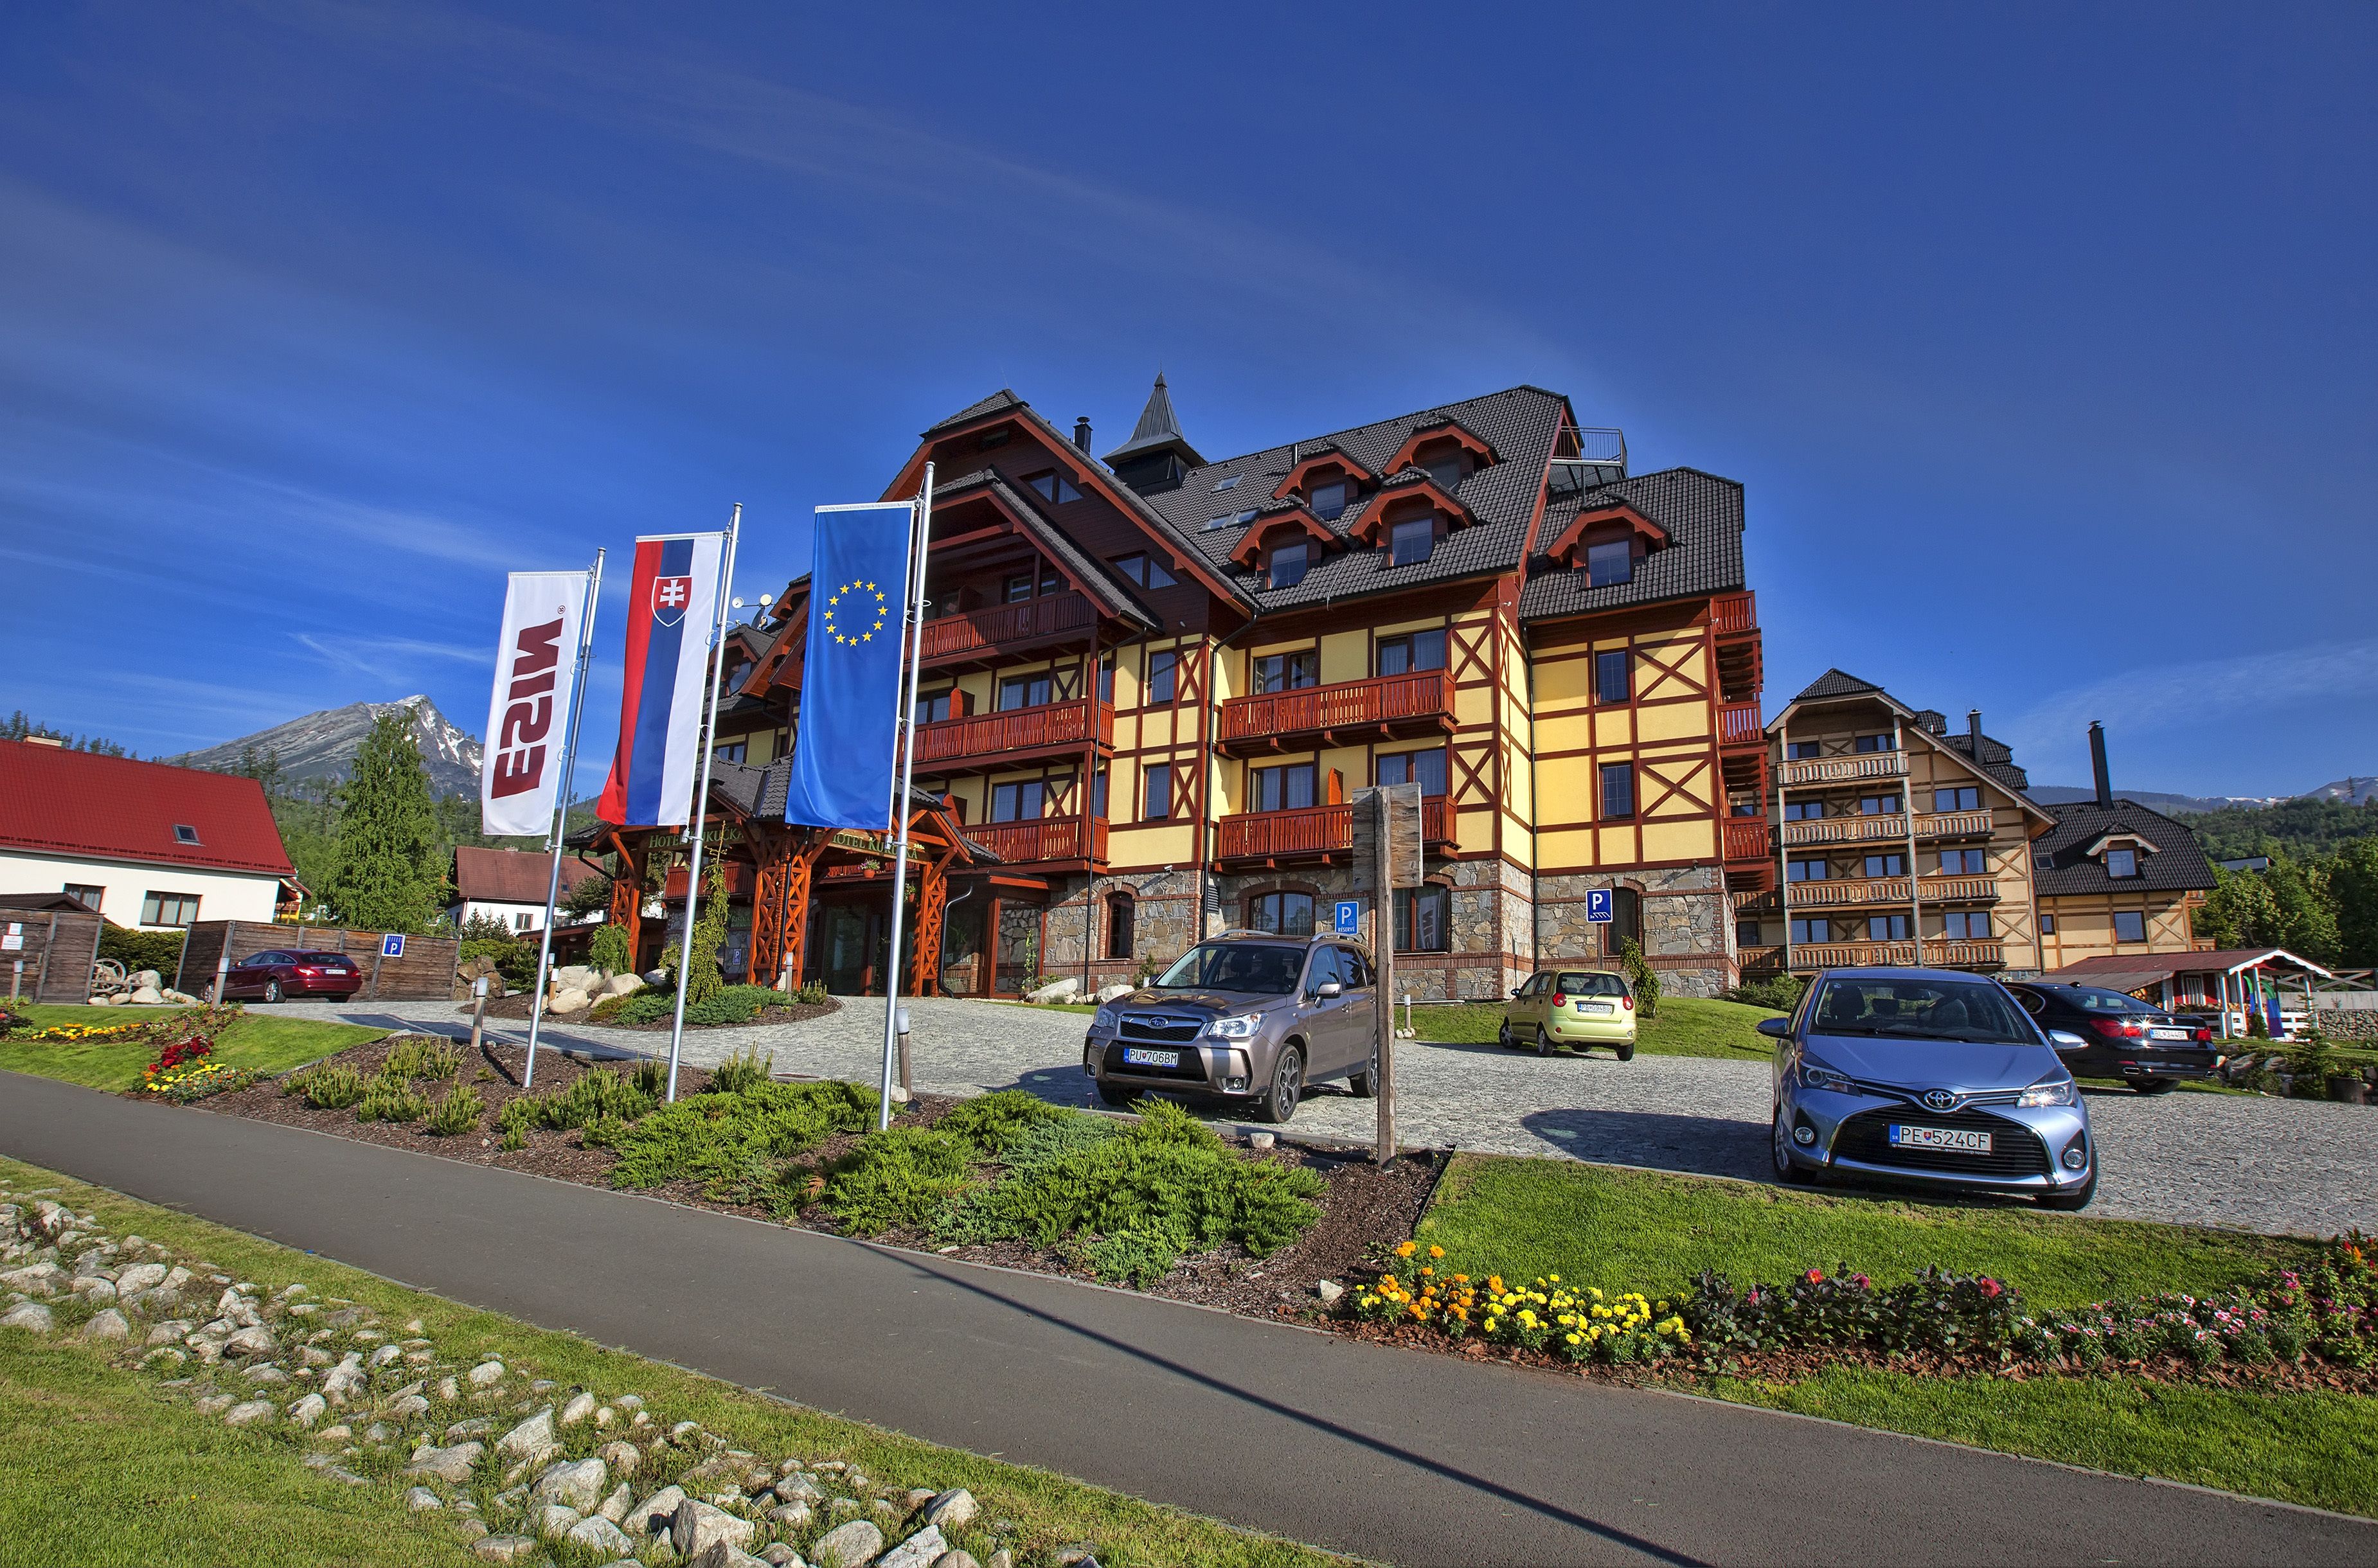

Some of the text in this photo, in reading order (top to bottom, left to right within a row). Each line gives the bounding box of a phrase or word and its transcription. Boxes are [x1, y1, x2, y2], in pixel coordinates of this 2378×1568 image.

[648, 833, 686, 848] HOTEL
[1592, 893, 1603, 910] P
[1341, 906, 1352, 925] P
[389, 943, 398, 954] P
